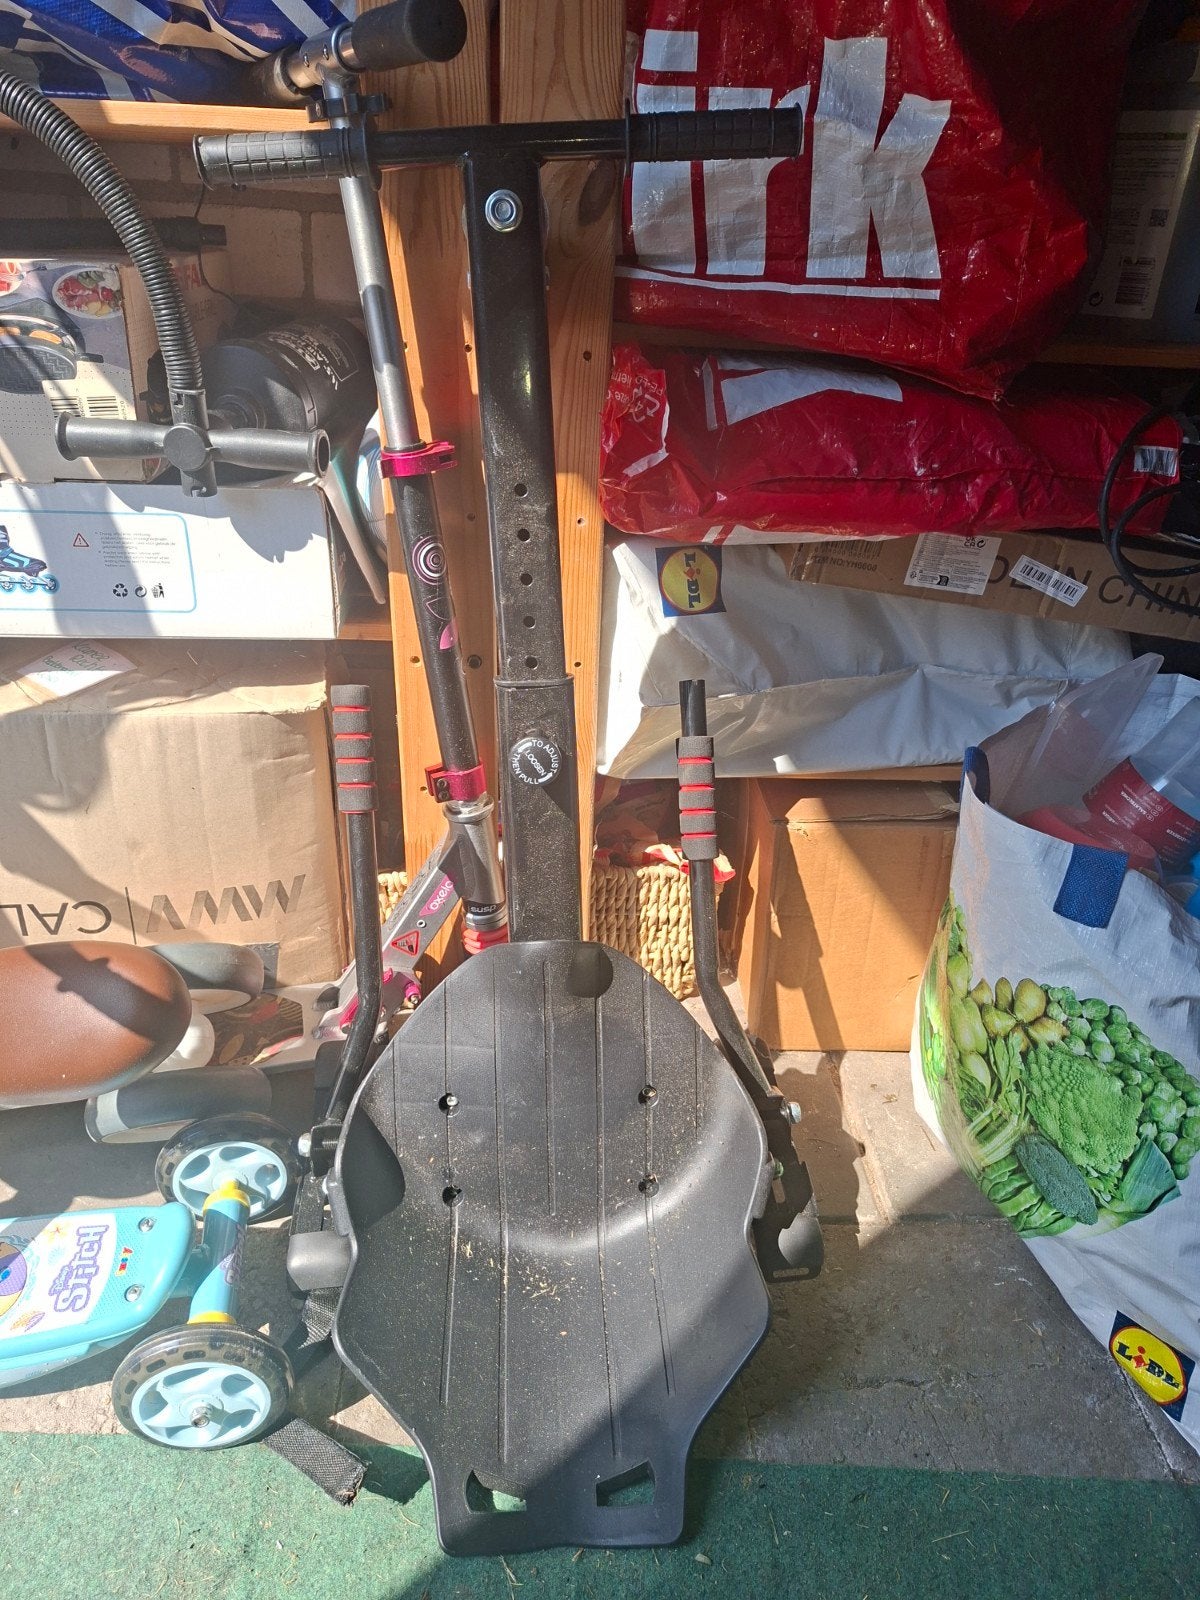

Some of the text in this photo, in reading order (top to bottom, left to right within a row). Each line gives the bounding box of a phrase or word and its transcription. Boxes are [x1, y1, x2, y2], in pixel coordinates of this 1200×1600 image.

[511, 753, 539, 785] THEN PULL
[525, 749, 547, 776] LOOSEN
[531, 739, 559, 774] TO ADJUST
[0, 901, 112, 936] CAL
